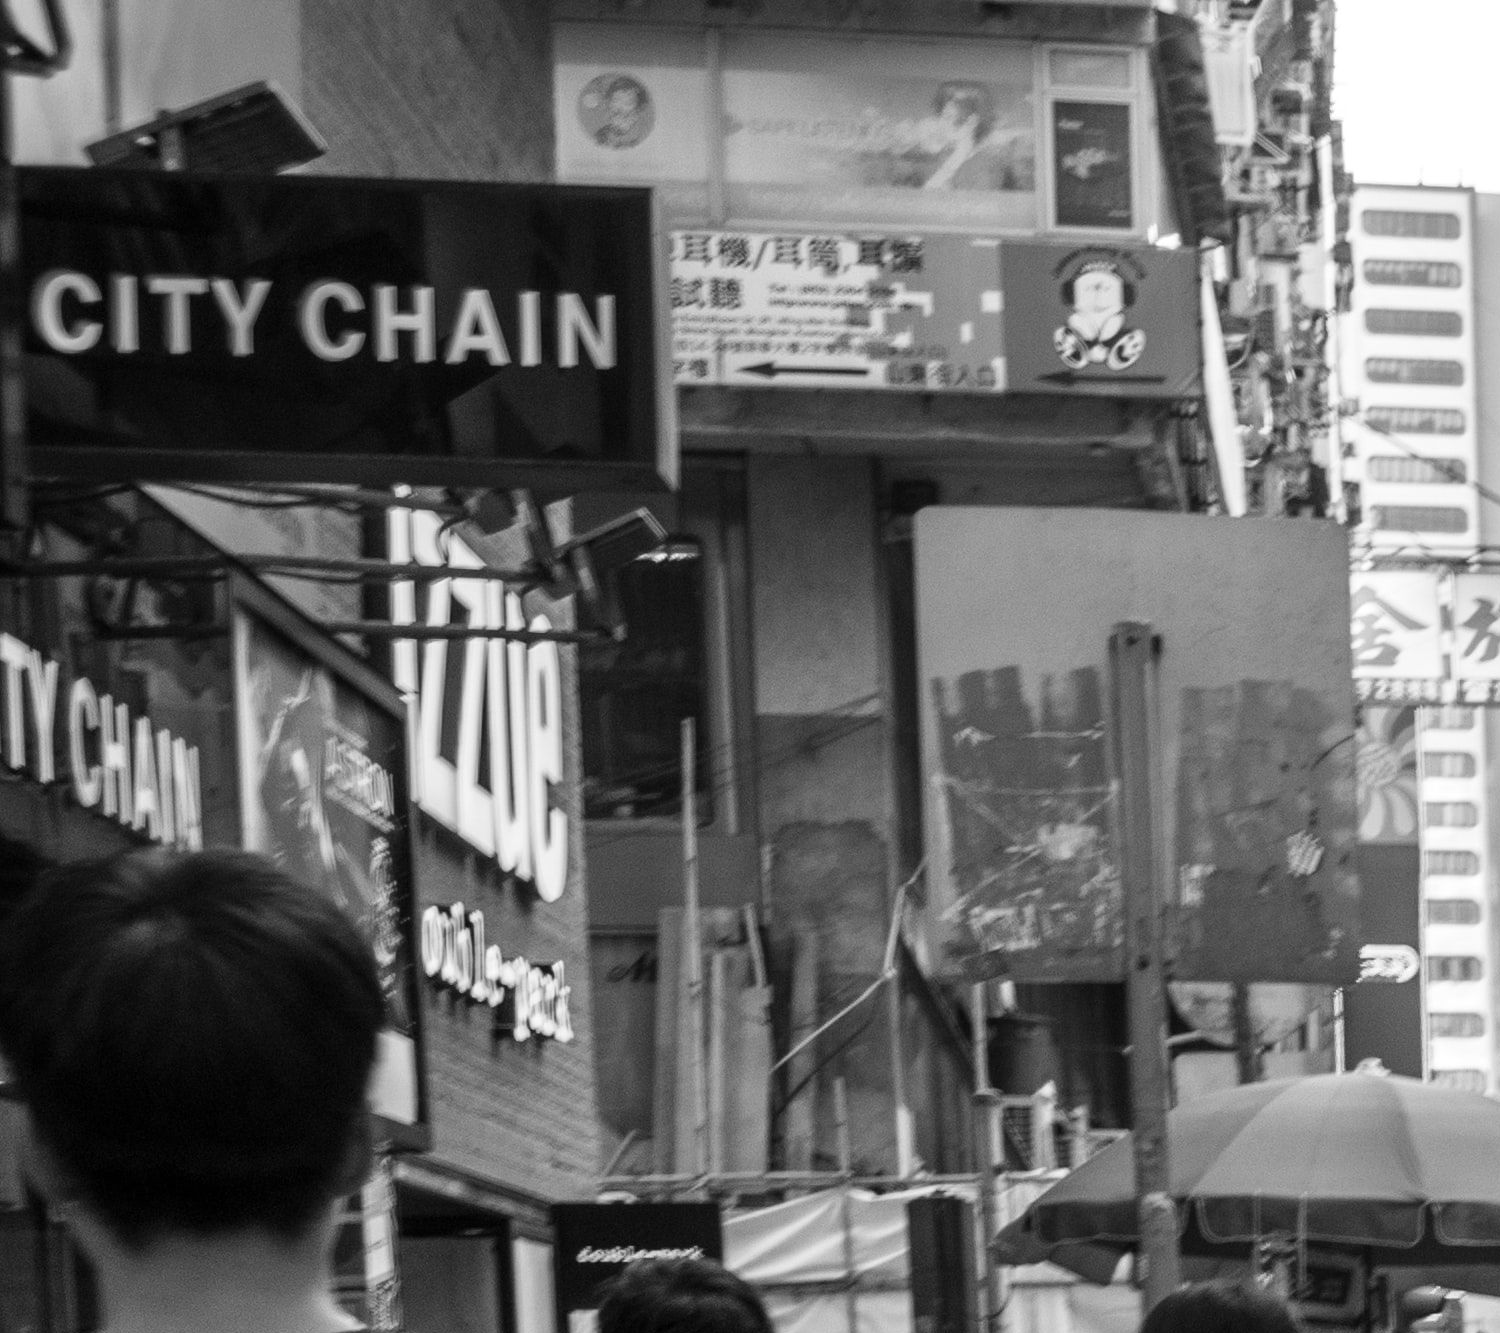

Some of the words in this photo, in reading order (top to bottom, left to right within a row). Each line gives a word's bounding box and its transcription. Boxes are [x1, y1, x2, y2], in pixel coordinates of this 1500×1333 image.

[31, 270, 274, 359] CITY
[295, 280, 618, 370] CHAIN
[0, 631, 60, 785] TY
[69, 676, 204, 854] CHAIN
[419, 901, 575, 1043] ouble-park
